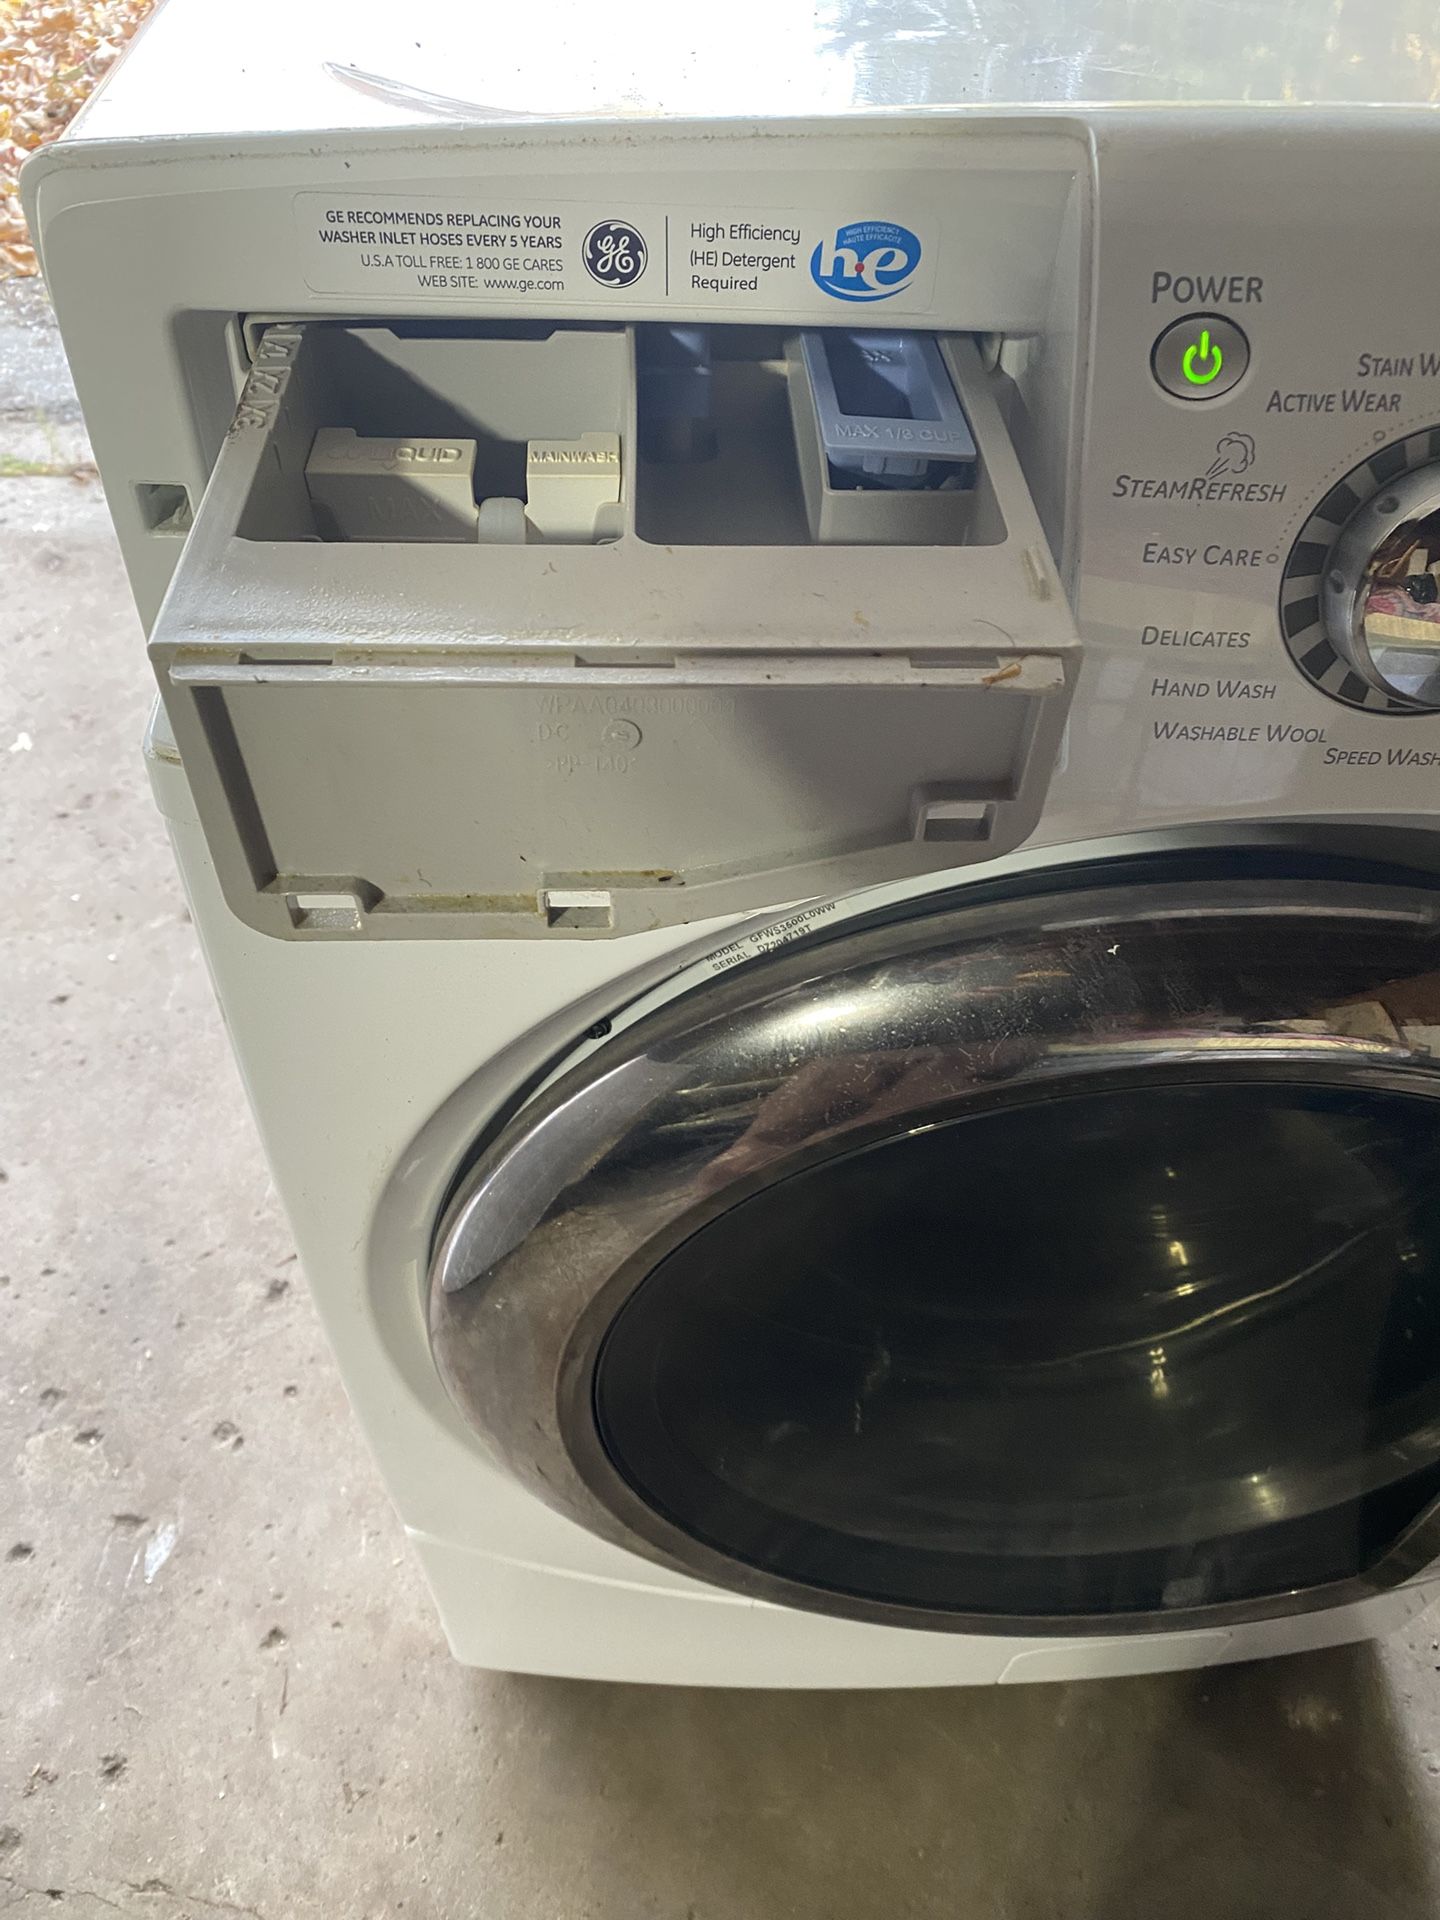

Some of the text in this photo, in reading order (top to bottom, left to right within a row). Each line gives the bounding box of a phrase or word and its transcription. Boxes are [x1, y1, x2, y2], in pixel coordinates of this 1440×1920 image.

[325, 210, 561, 229] GE RECOMMENDS REPLACING YOUR
[319, 230, 562, 249] WASHER INLET HOSES EVERY 5 YEARS
[691, 223, 800, 245] High Efficiency
[361, 254, 563, 272] U.S.A TOLL FREE: 1 800 GE CARES
[690, 250, 796, 272] (HE) Detergent
[417, 274, 565, 293] WEB SITE: www.ge.com
[691, 275, 758, 292] Required
[1151, 271, 1264, 303] POWER
[1357, 352, 1414, 377] STAIN
[1266, 390, 1401, 413] ACTIVE WEAR
[834, 423, 880, 439] MAX
[920, 429, 961, 442] CUP
[529, 450, 619, 463] MAINWASH
[1142, 542, 1263, 567] EASY CARE
[1141, 626, 1251, 648] DELICATES
[1151, 678, 1276, 700] HAND WASH
[1153, 721, 1327, 744] WASHABLE WOOL
[1323, 747, 1381, 767] SPEED
[705, 942, 744, 962] MODEL
[712, 951, 751, 971] SERIAL
